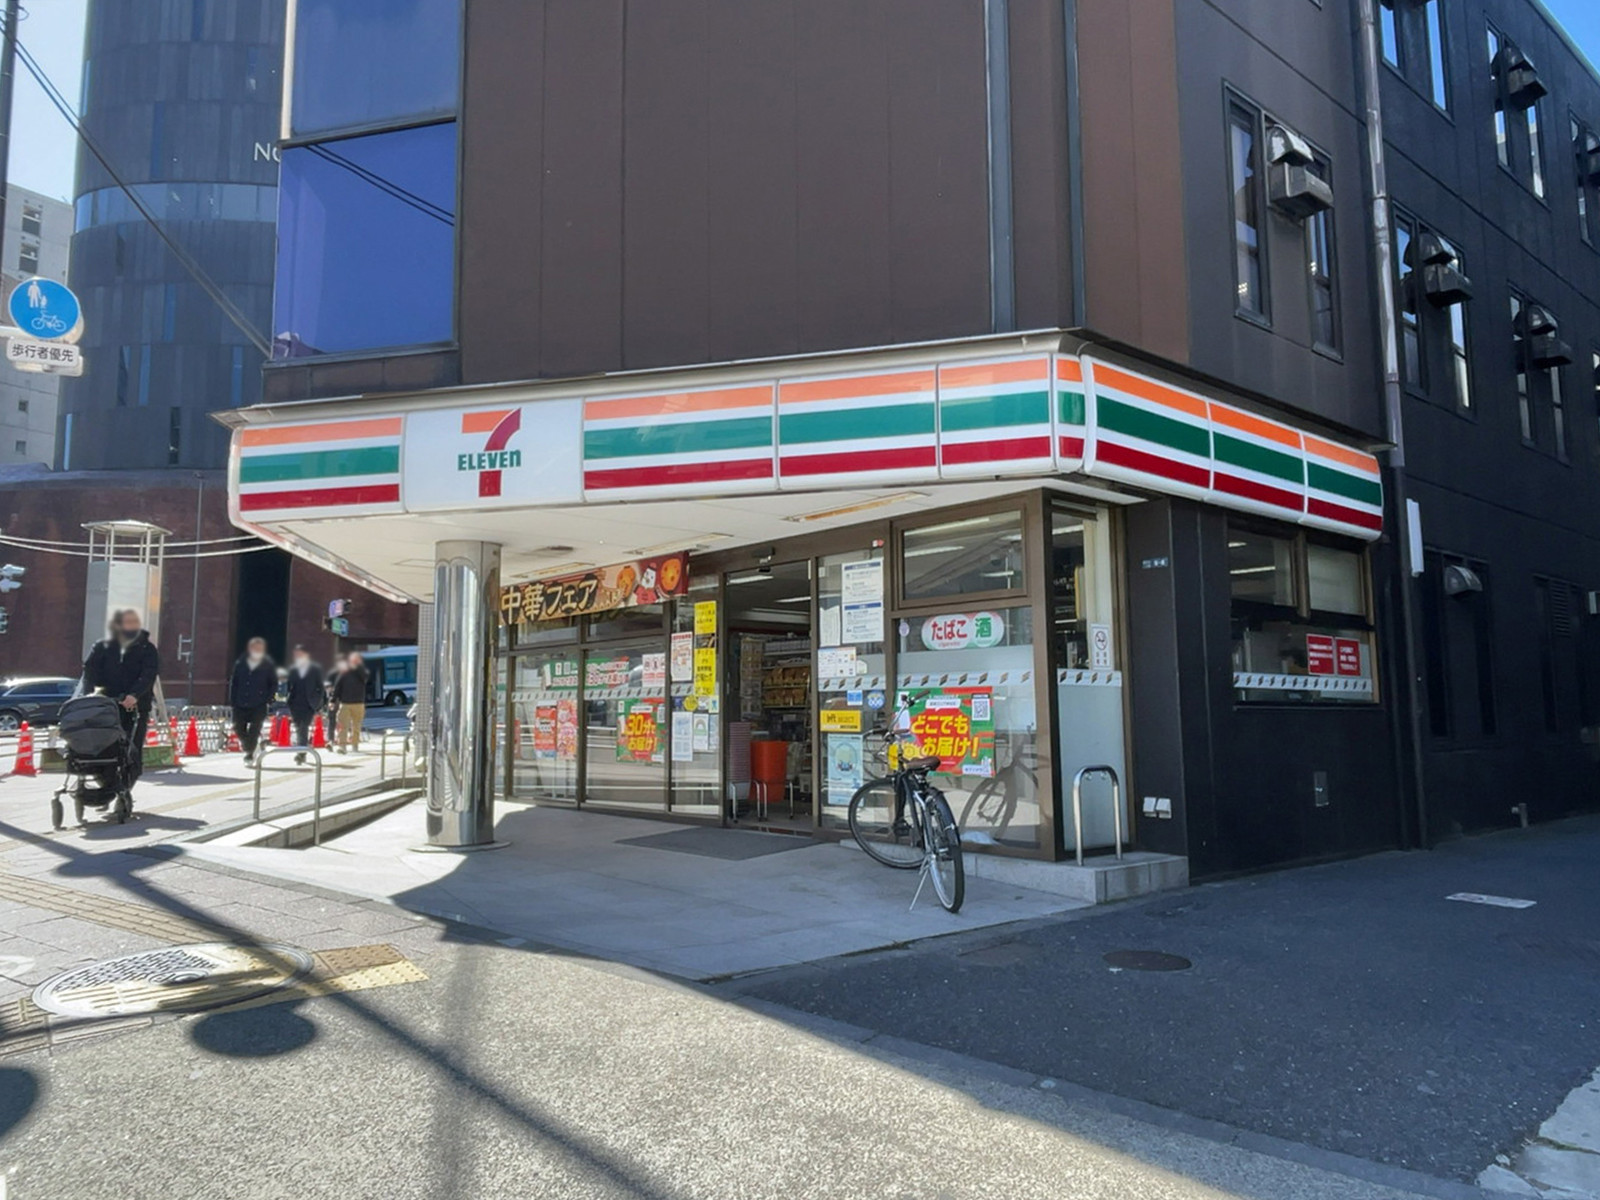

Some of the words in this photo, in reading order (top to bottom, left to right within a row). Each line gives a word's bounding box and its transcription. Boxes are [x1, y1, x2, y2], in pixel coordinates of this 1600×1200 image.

[11, 343, 74, 362] 歩行者優先
[462, 408, 522, 498] 7
[501, 578, 598, 625] 中華フェア
[931, 619, 968, 641] たばこ
[975, 616, 992, 638] 酒
[911, 714, 969, 735] どこでも
